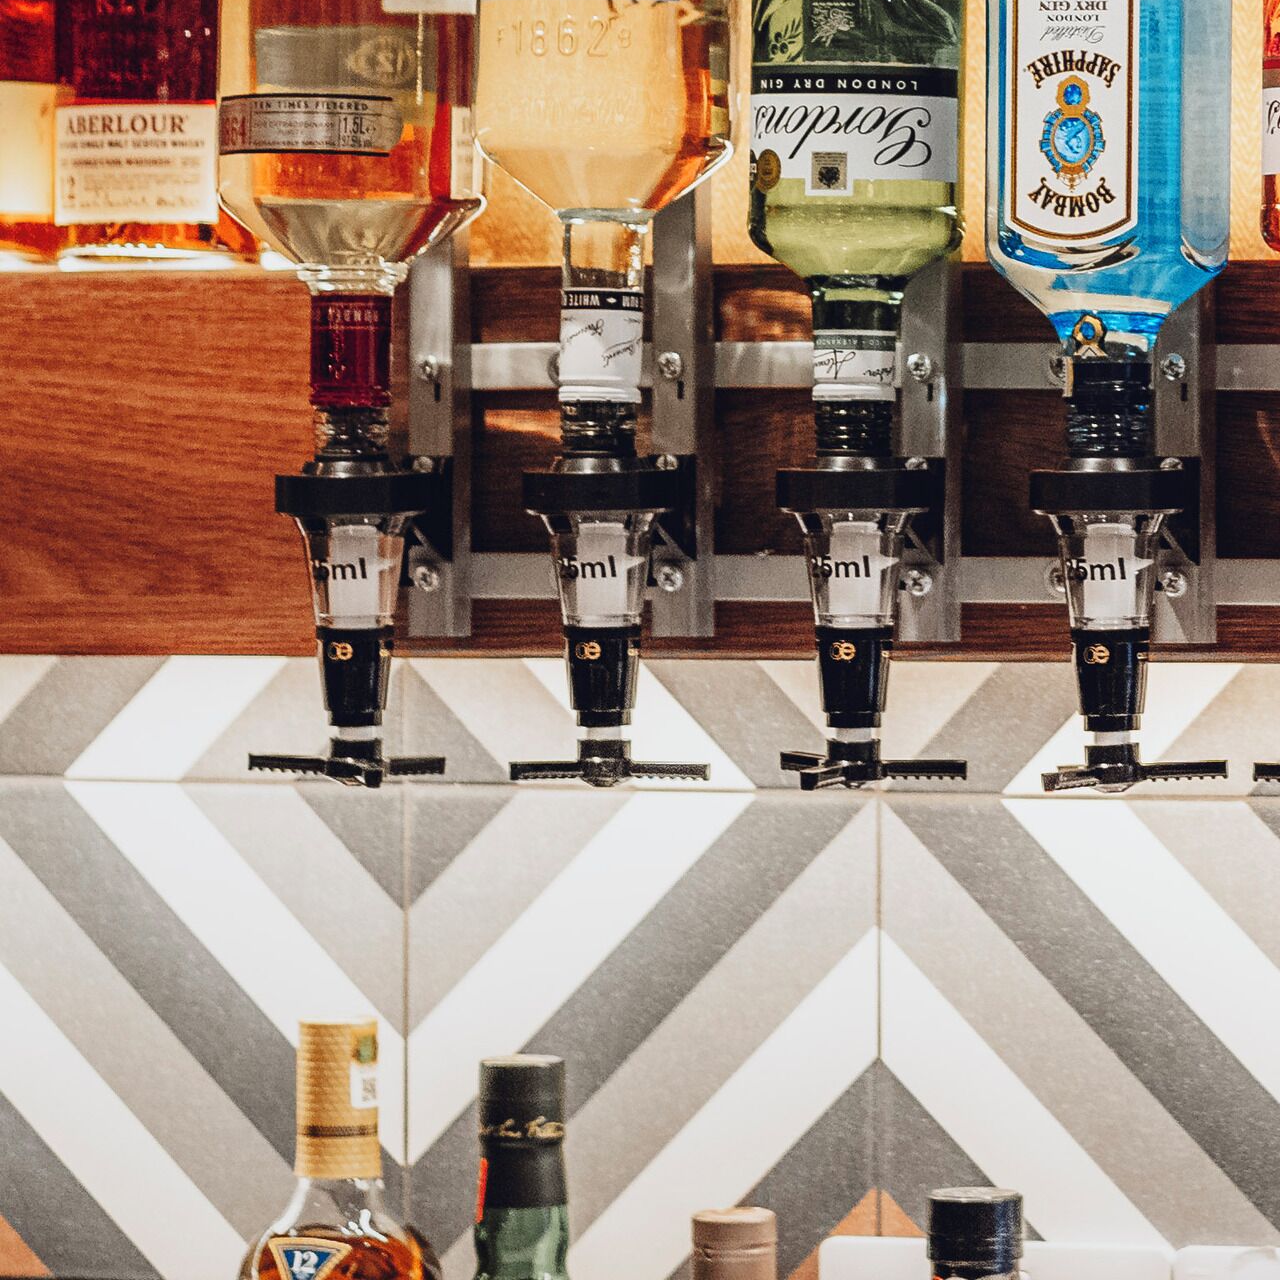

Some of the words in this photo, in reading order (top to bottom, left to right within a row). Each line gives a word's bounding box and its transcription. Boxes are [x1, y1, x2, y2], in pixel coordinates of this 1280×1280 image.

[1039, 0, 1071, 11] GIN
[1073, 0, 1108, 11] DRY
[1046, 14, 1099, 22] LONDON
[1040, 25, 1106, 44] Distilled
[1026, 49, 1122, 89] SAPPHIRE
[759, 79, 783, 90] GIN
[793, 78, 824, 89] DRY
[837, 79, 918, 91] LONDON
[67, 114, 185, 135] ABERLOUR
[754, 105, 932, 168] Gordon's
[1028, 177, 1117, 218] BOMBAY
[291, 1250, 319, 1274] 12
